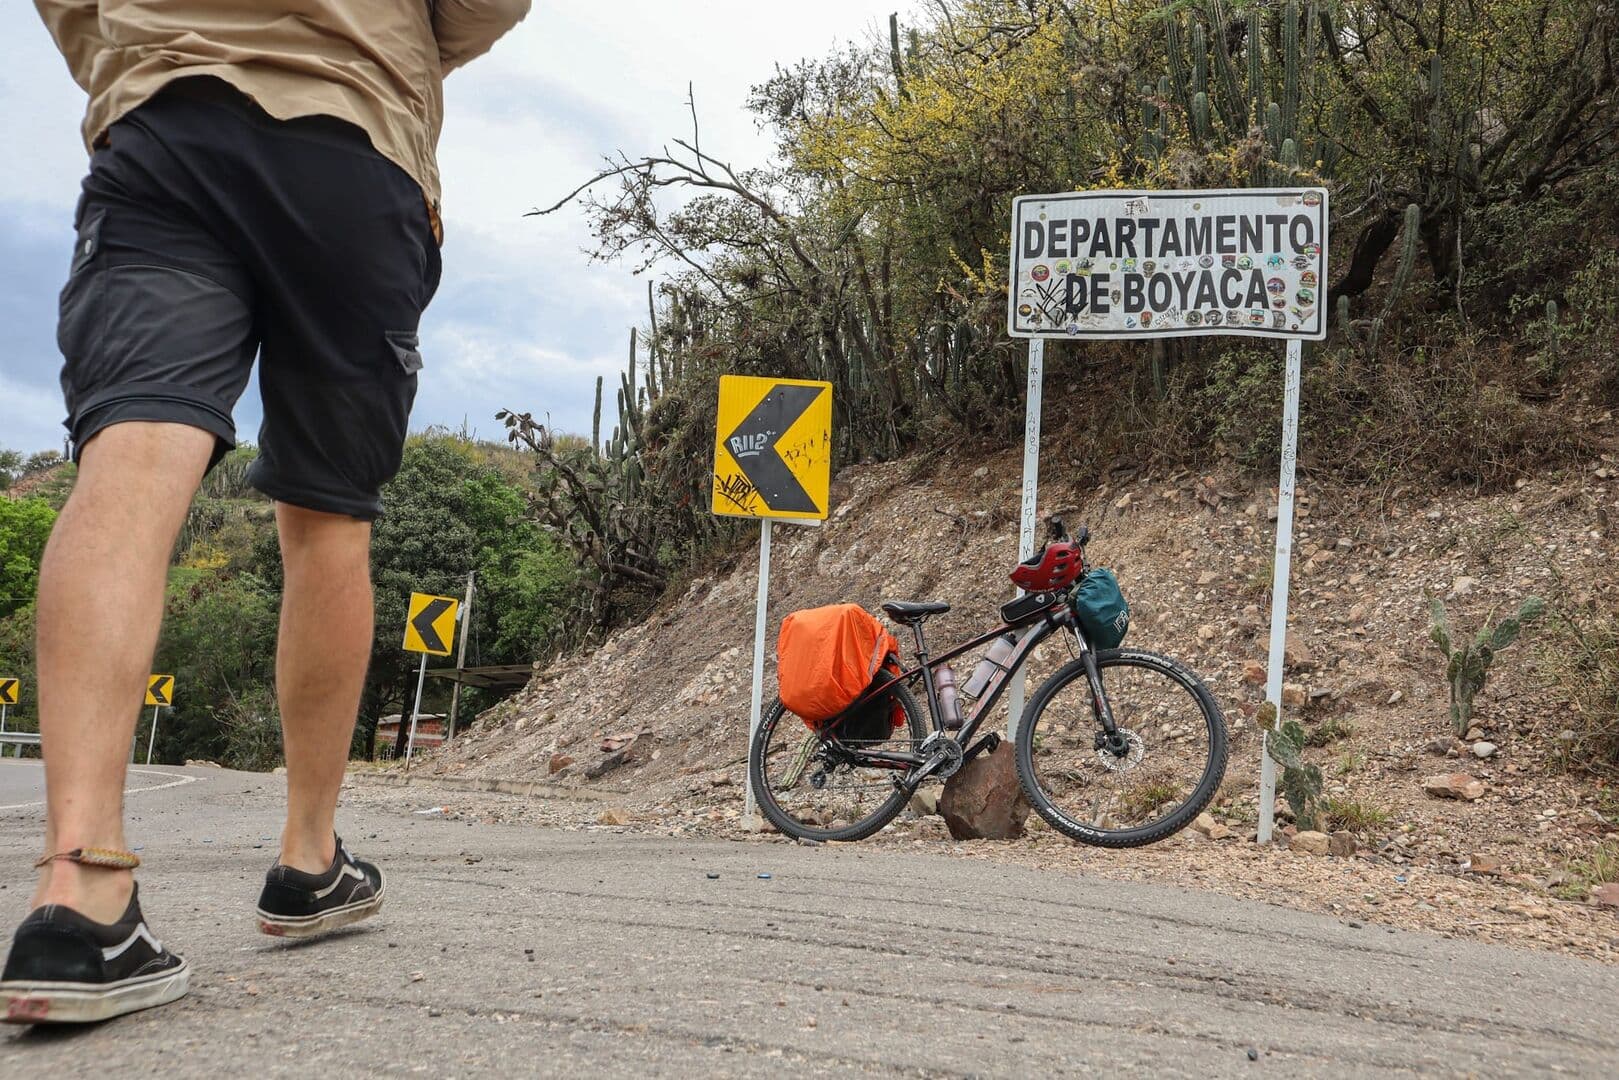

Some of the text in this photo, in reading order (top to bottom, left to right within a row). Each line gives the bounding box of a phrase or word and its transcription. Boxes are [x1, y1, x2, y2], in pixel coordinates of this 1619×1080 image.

[1023, 214, 1314, 259] DEPARTAMENTO
[1066, 272, 1111, 314] DE
[1124, 268, 1270, 314] BOYACA
